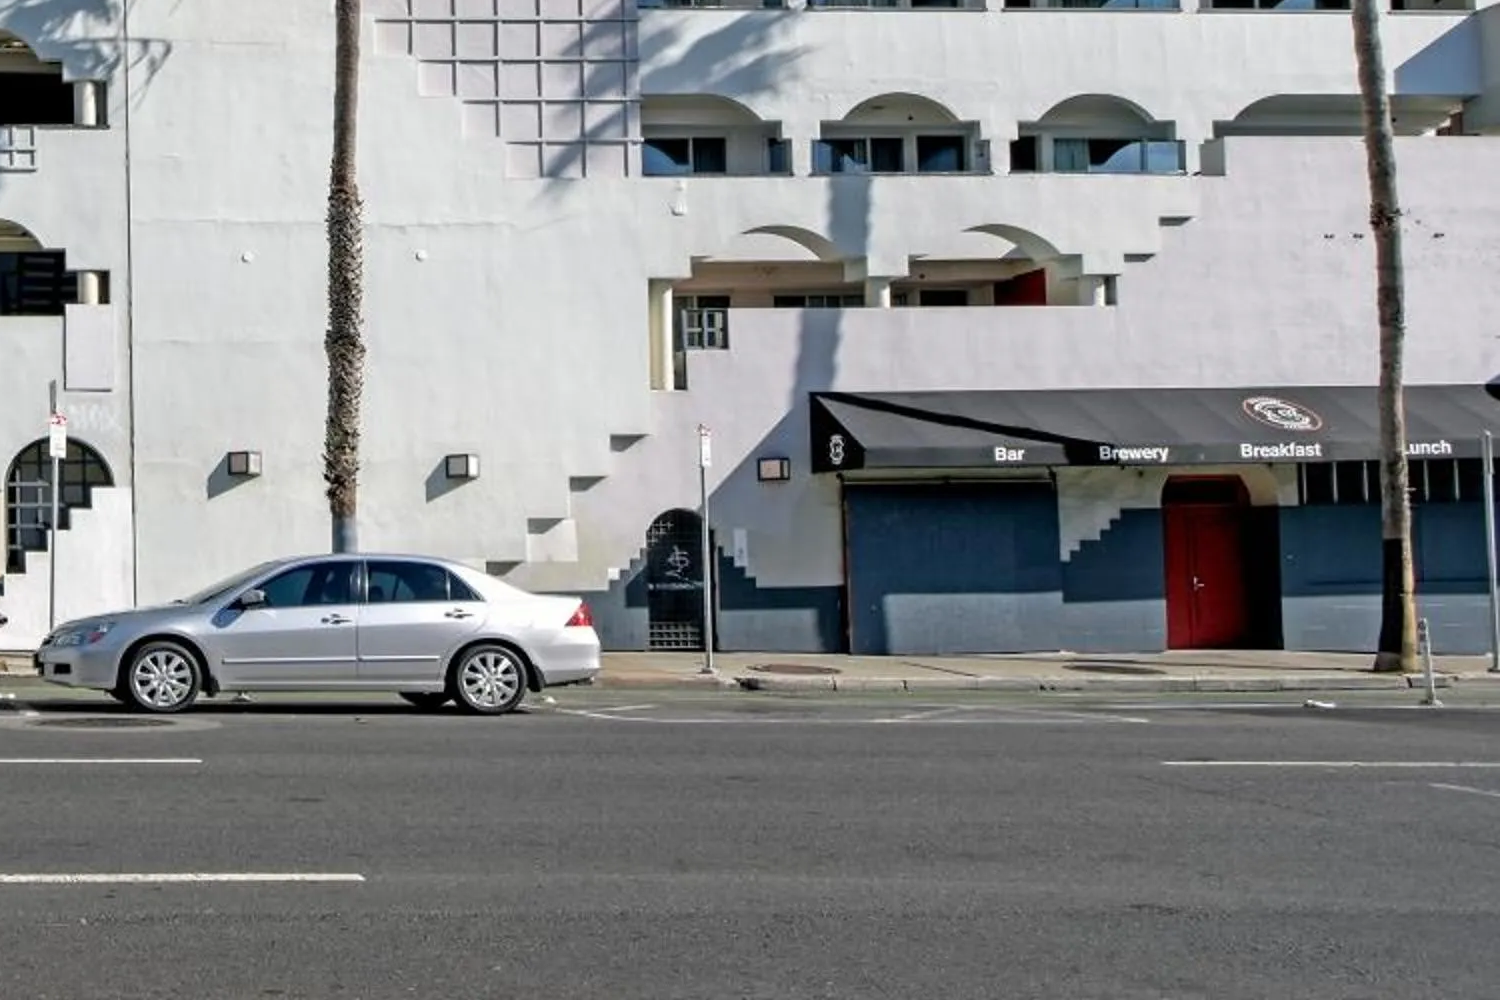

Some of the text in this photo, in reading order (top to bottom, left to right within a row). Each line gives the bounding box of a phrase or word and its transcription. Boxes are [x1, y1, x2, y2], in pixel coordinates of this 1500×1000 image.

[994, 446, 1025, 461] Bar
[1099, 445, 1169, 463] Brewery
[1239, 442, 1322, 458] Breakfast
